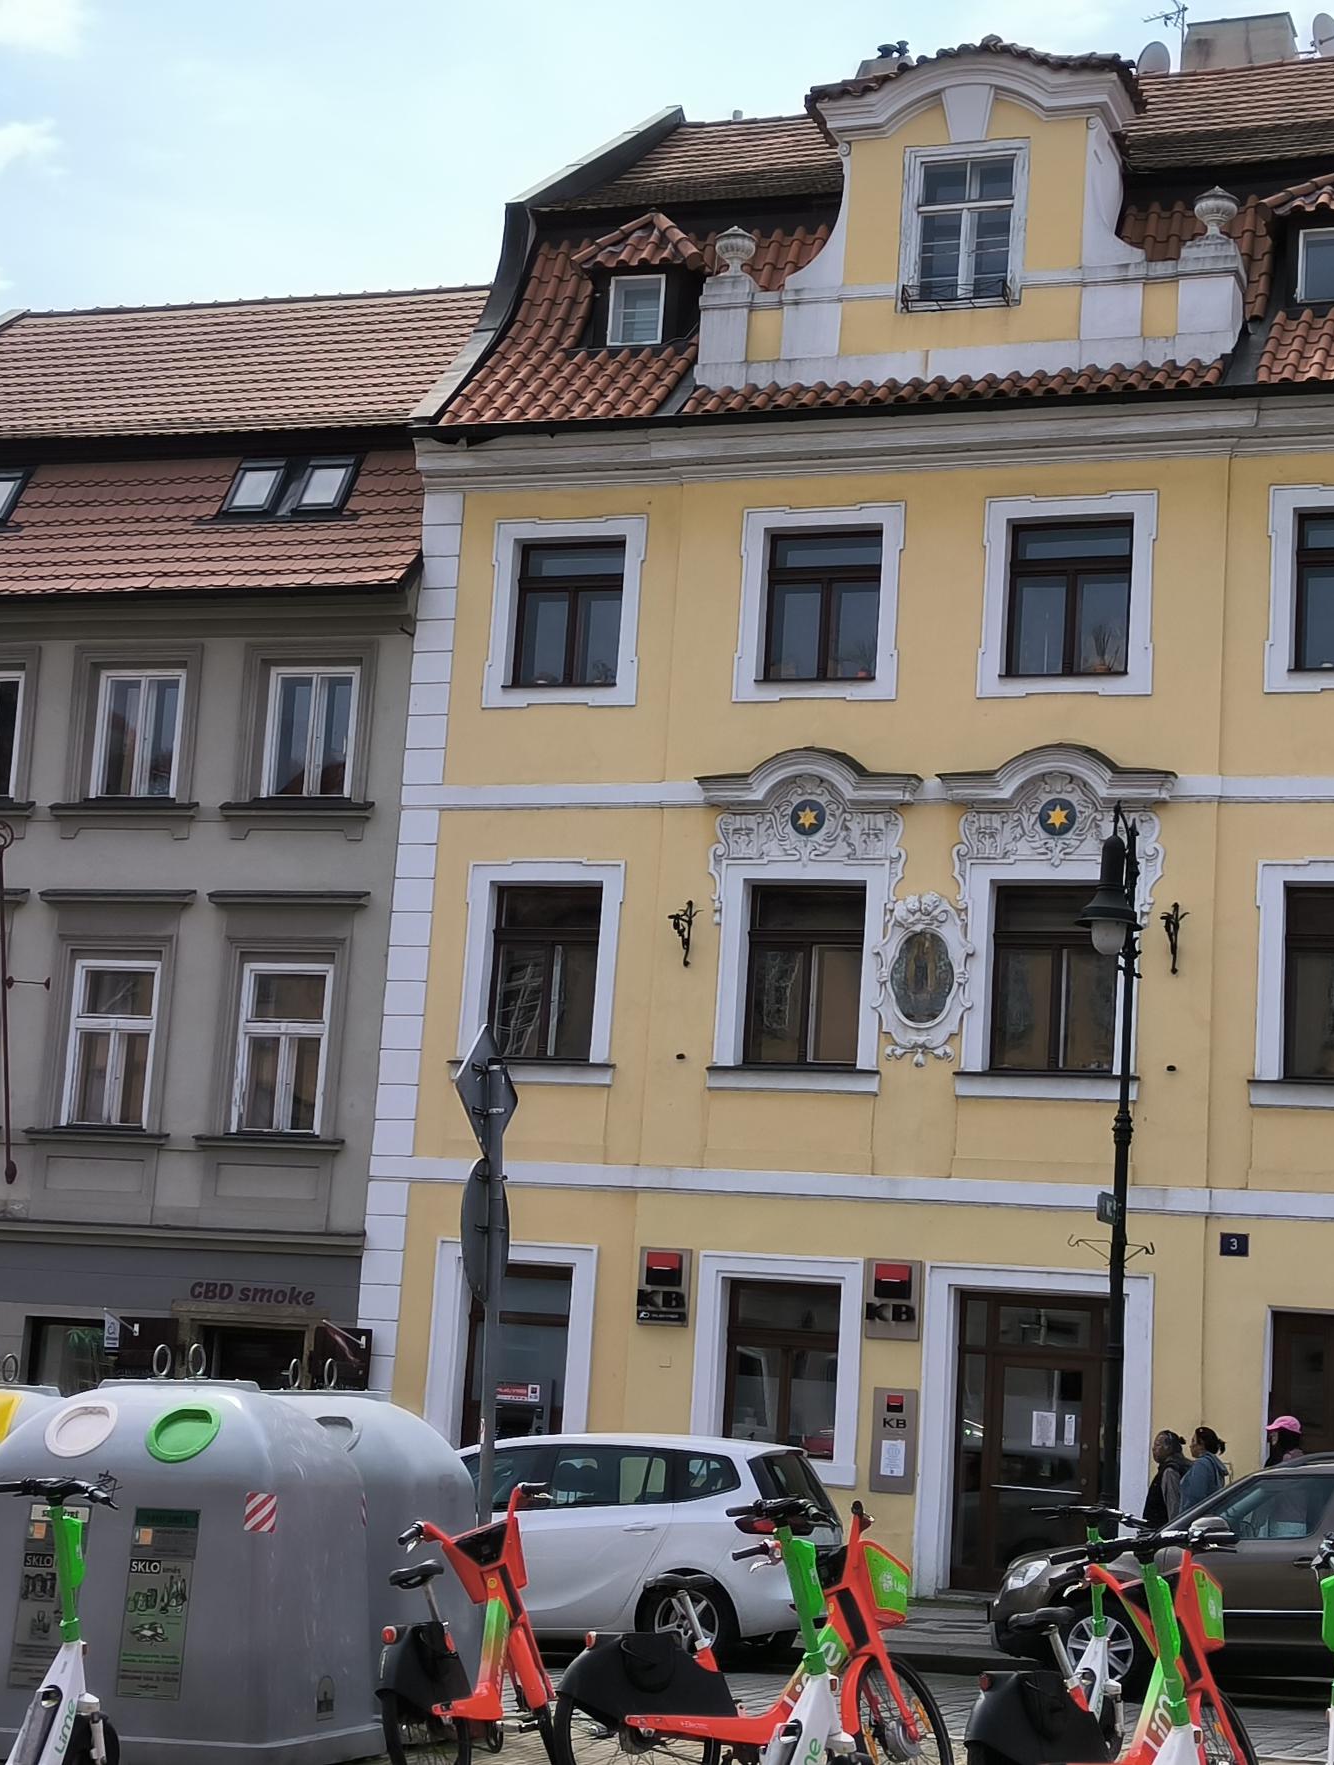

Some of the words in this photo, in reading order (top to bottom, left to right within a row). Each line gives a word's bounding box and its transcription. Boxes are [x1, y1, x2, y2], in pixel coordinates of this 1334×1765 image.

[1229, 1237, 1238, 1250] 3
[189, 1281, 234, 1301] CBD
[238, 1287, 316, 1307] smoke
[636, 1288, 686, 1309] KB
[865, 1302, 916, 1322] KB
[882, 1417, 907, 1429] KB
[25, 1555, 54, 1568] SKLO
[130, 1560, 161, 1574] SKLO
[54, 1698, 76, 1755] Lime
